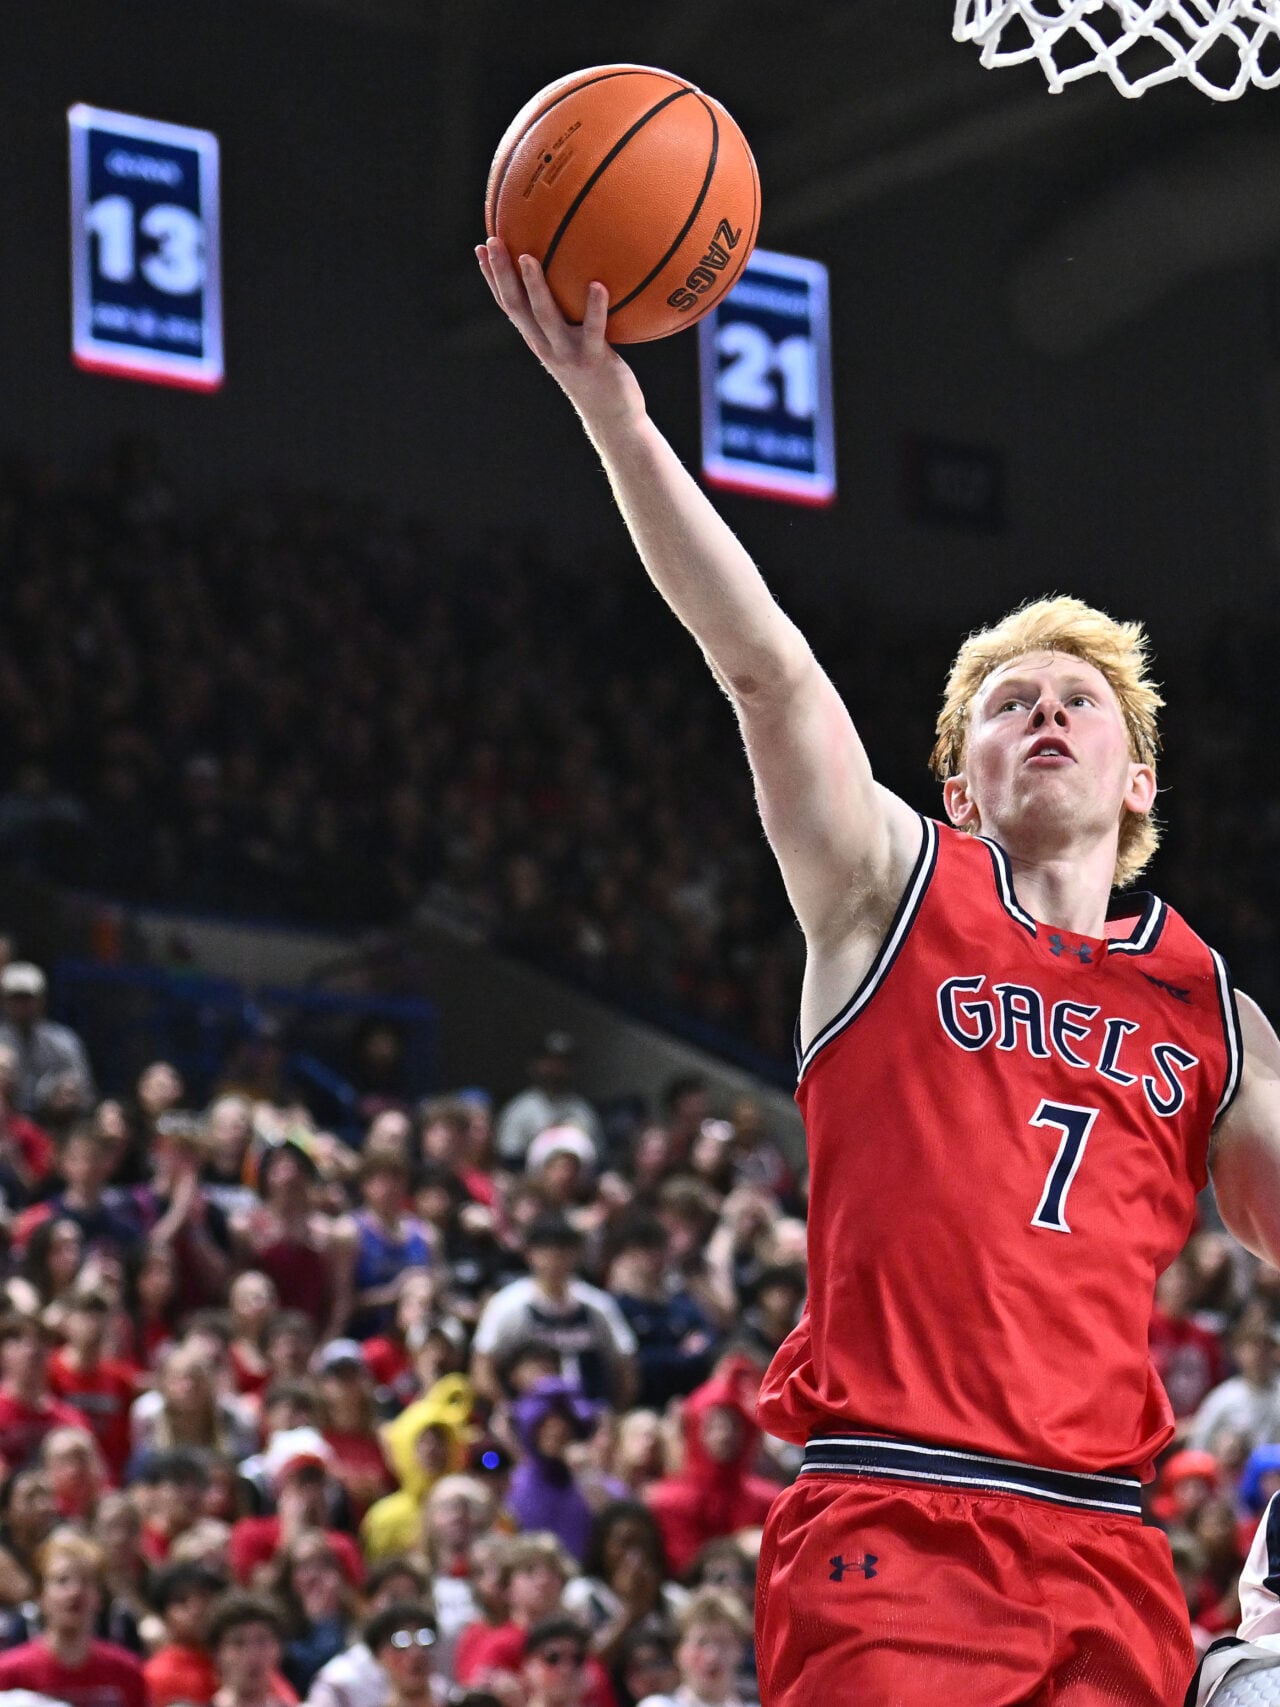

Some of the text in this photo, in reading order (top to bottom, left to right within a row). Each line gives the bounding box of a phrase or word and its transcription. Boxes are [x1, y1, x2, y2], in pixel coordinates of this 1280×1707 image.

[85, 195, 206, 295] 13
[667, 218, 742, 312] ZAGS
[714, 321, 817, 421] 21
[937, 974, 1199, 1117] GAELS
[1028, 1098, 1100, 1234] 7
